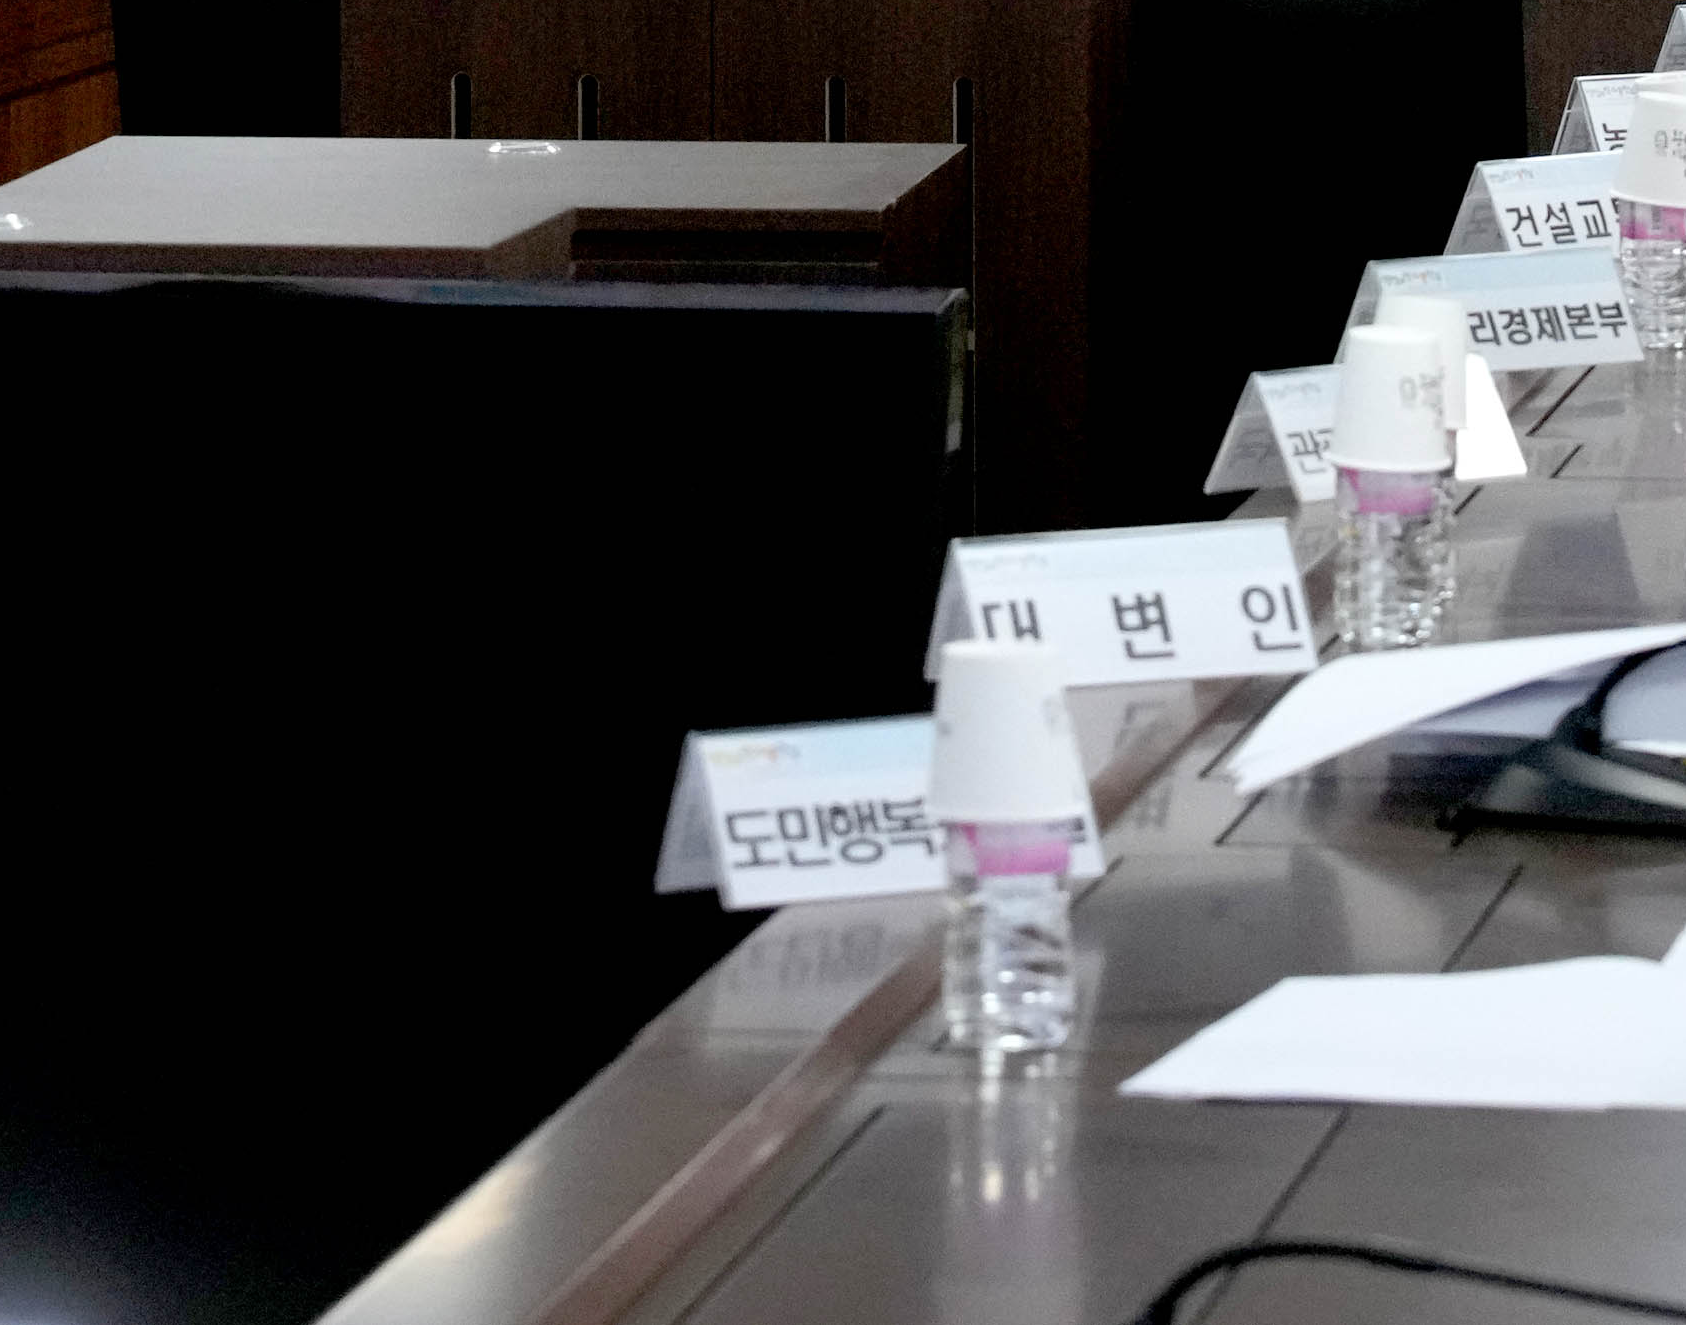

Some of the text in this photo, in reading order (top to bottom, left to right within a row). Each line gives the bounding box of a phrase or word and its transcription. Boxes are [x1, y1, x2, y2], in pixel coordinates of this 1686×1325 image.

[1505, 197, 1620, 247] 건설교
[1467, 302, 1628, 346] 리경제본부
[725, 795, 937, 870] 도민행복
